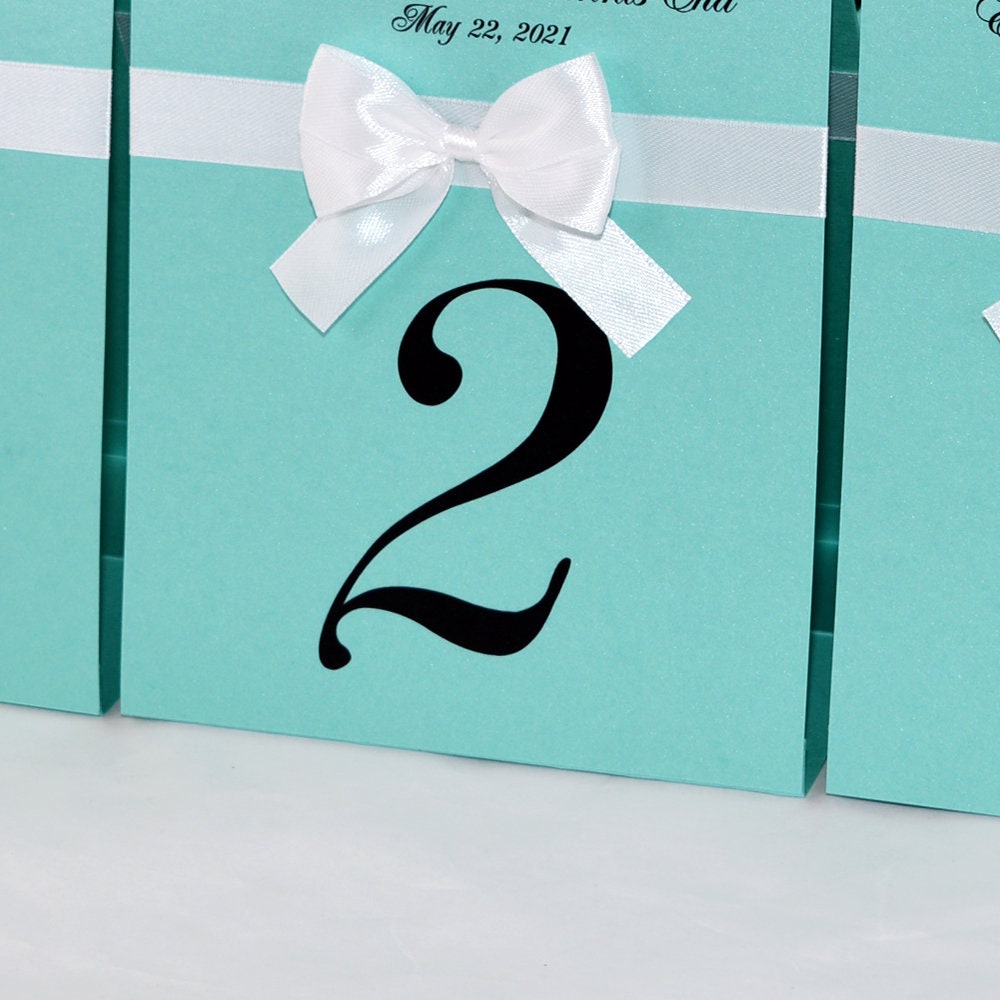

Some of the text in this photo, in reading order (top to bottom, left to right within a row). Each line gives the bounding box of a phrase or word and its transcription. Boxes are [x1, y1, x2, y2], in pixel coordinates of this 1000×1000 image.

[391, 4, 571, 46] May 22, 2021
[319, 278, 613, 670] 2
